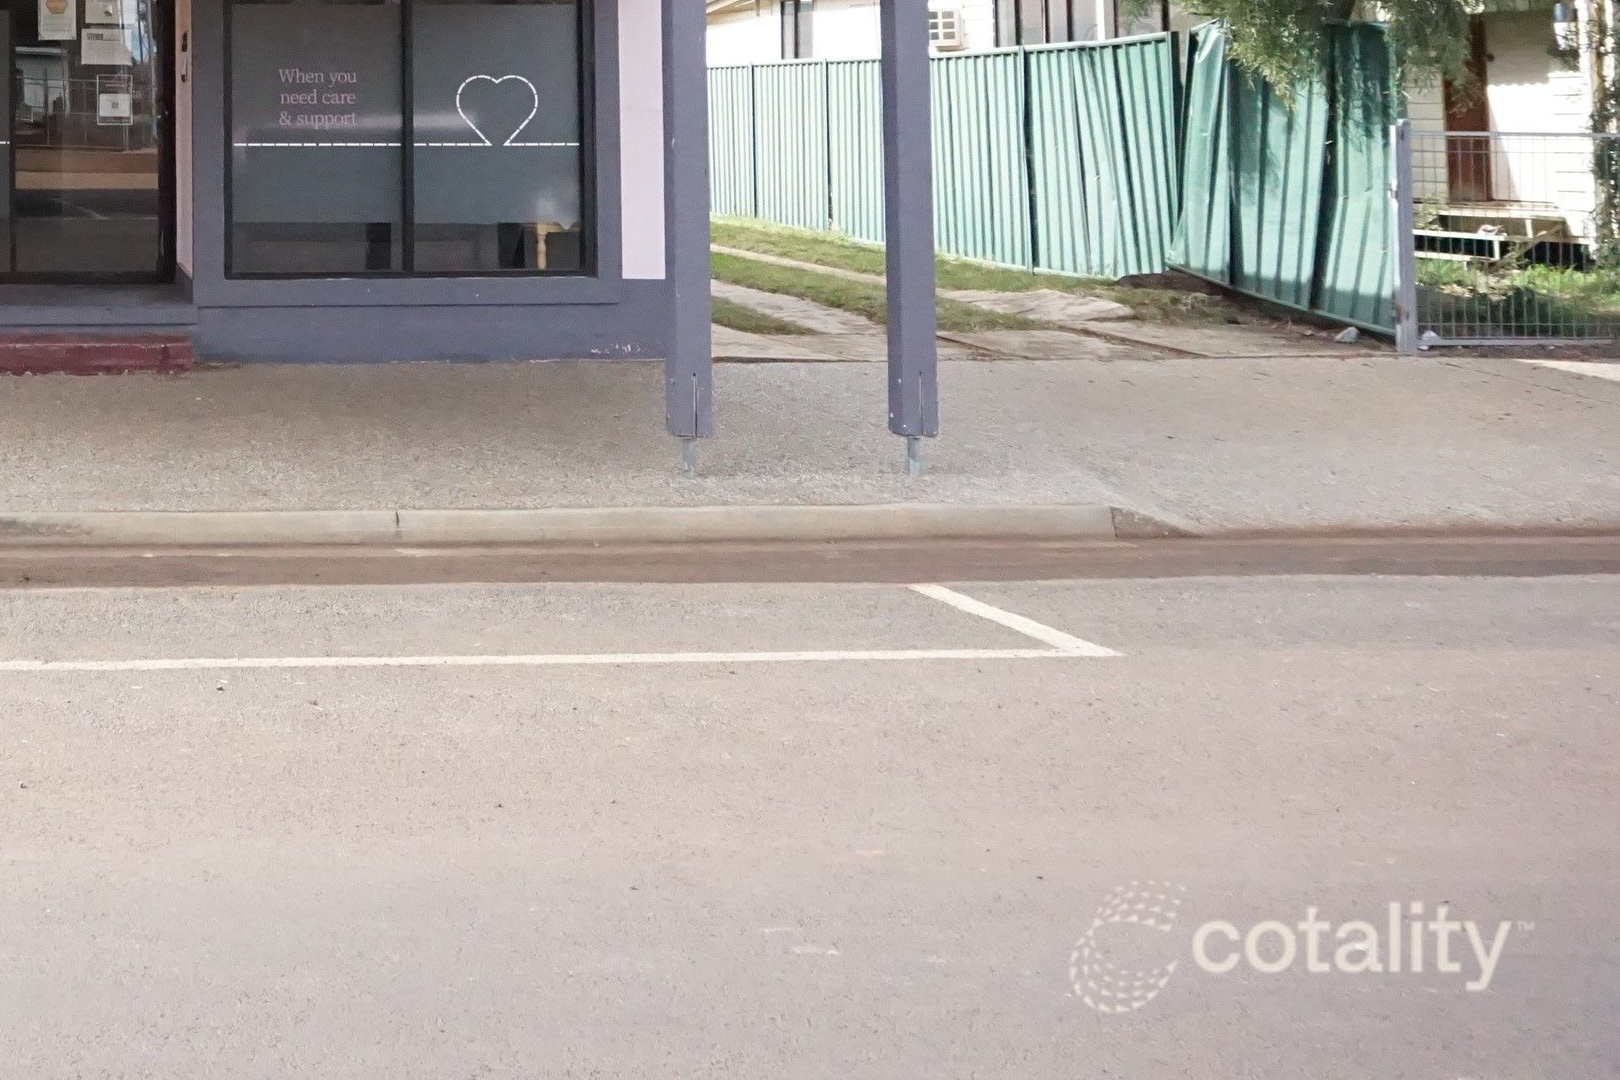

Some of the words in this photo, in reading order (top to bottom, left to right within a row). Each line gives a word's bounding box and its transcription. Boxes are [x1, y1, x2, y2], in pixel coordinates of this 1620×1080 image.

[279, 68, 324, 84] When
[327, 72, 357, 88] you
[280, 89, 317, 105] need
[322, 93, 356, 105] care
[279, 110, 292, 126] &
[297, 112, 357, 130] support
